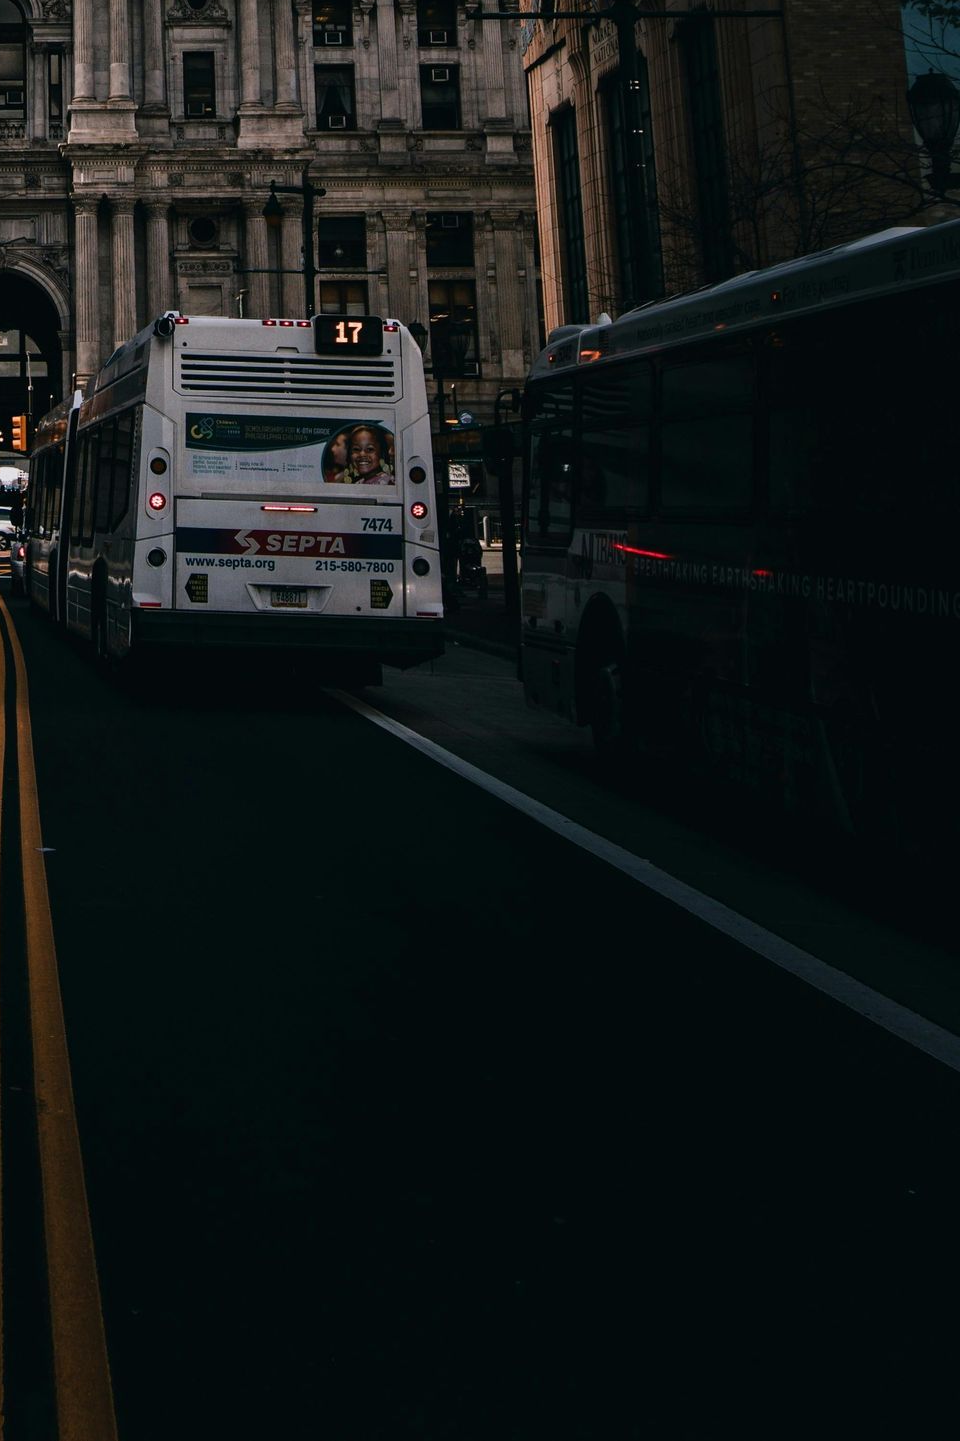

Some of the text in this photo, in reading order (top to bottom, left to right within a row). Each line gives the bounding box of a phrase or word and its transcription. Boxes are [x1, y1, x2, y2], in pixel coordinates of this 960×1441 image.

[335, 321, 363, 344] 17
[361, 517, 393, 532] 7474
[265, 534, 346, 554] SEPTA
[185, 556, 276, 572] www.septa.org
[315, 560, 395, 574] 215-580-7800
